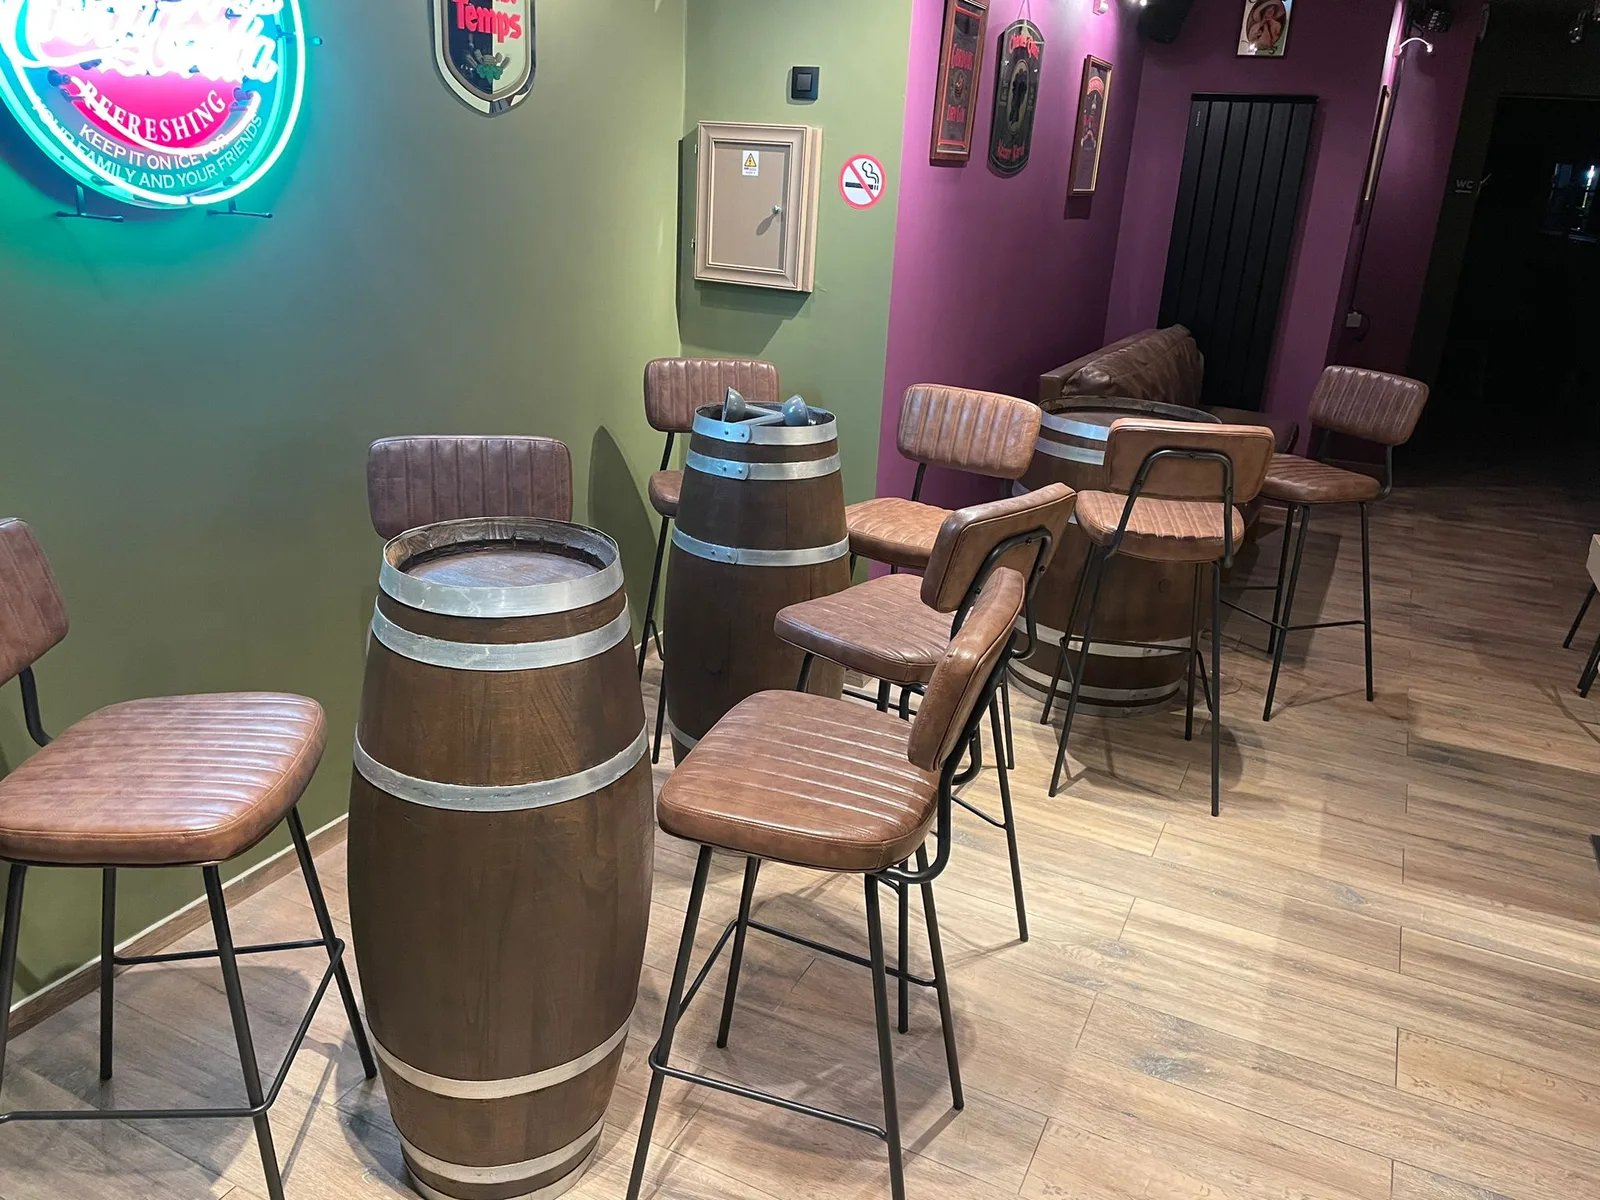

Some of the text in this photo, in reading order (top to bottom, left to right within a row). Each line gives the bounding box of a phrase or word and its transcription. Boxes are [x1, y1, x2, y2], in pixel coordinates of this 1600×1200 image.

[452, 0, 522, 43] Temps
[83, 80, 226, 142] REFRESHING
[77, 141, 137, 183] FAMILY
[138, 172, 175, 189] AND
[176, 163, 218, 187] YOUR
[217, 115, 262, 171] FRIENDS
[79, 124, 126, 158] KEEP
[128, 150, 144, 167] IT
[147, 155, 172, 170] ON
[174, 154, 201, 170] ICE
[1456, 179, 1474, 189] WC
